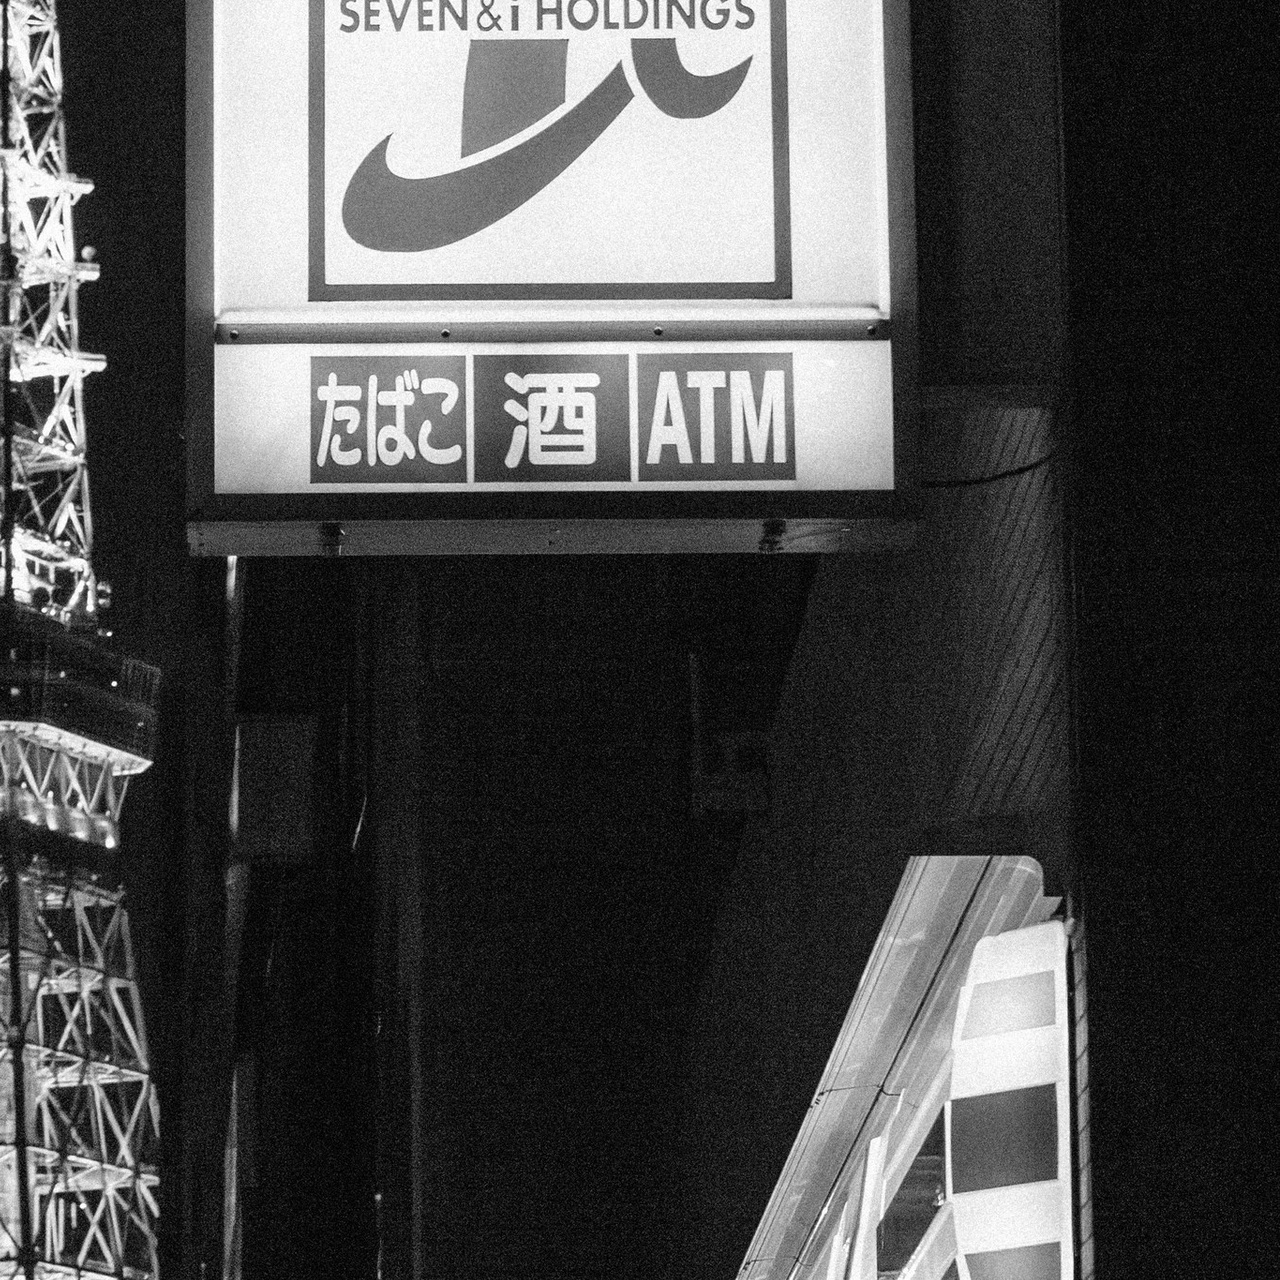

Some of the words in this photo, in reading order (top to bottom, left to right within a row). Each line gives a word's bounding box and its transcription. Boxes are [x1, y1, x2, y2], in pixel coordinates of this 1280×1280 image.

[316, 368, 462, 467] たばこ
[503, 371, 601, 469] 酒
[646, 370, 788, 465] ATM
